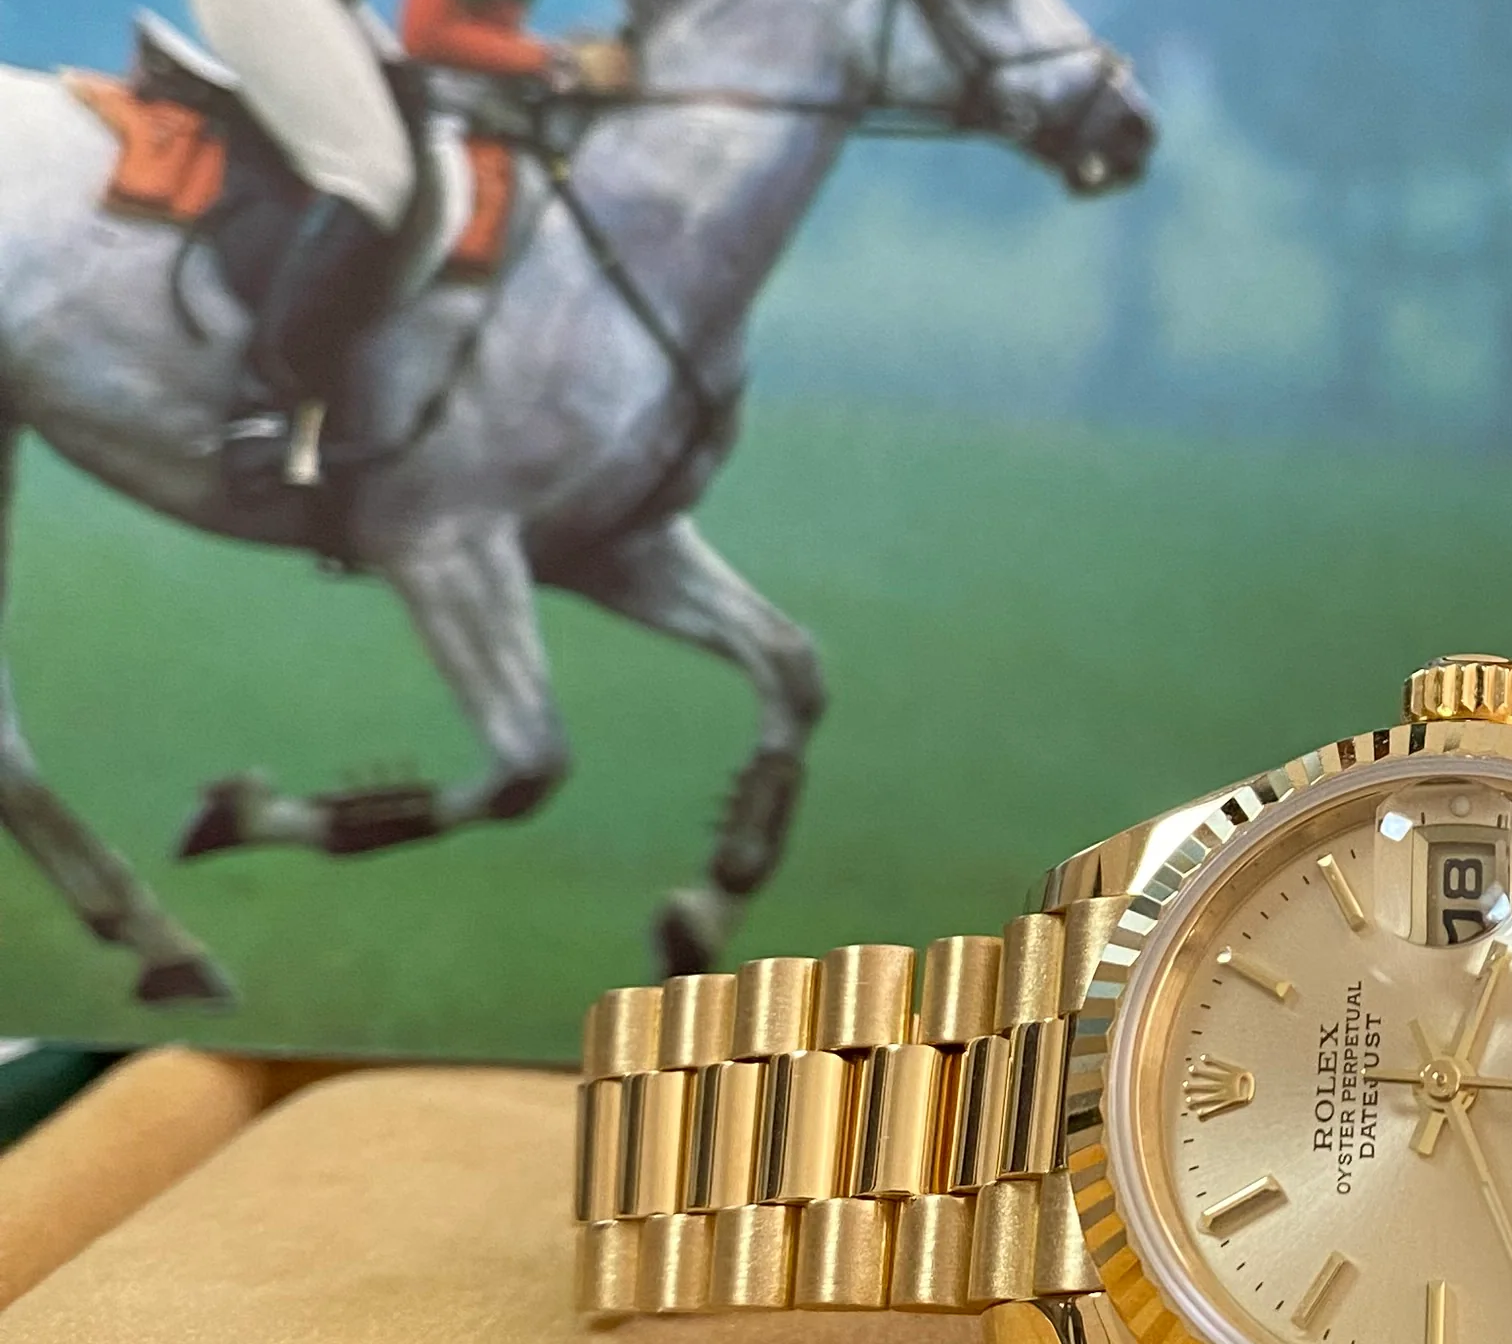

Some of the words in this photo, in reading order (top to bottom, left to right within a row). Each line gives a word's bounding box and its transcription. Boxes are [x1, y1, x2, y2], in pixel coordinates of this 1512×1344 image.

[1443, 858, 1484, 944] 18
[1313, 1022, 1339, 1152] ROLEX
[1342, 980, 1362, 1103] PERPETUAL
[1337, 1109, 1356, 1195] OYSTER
